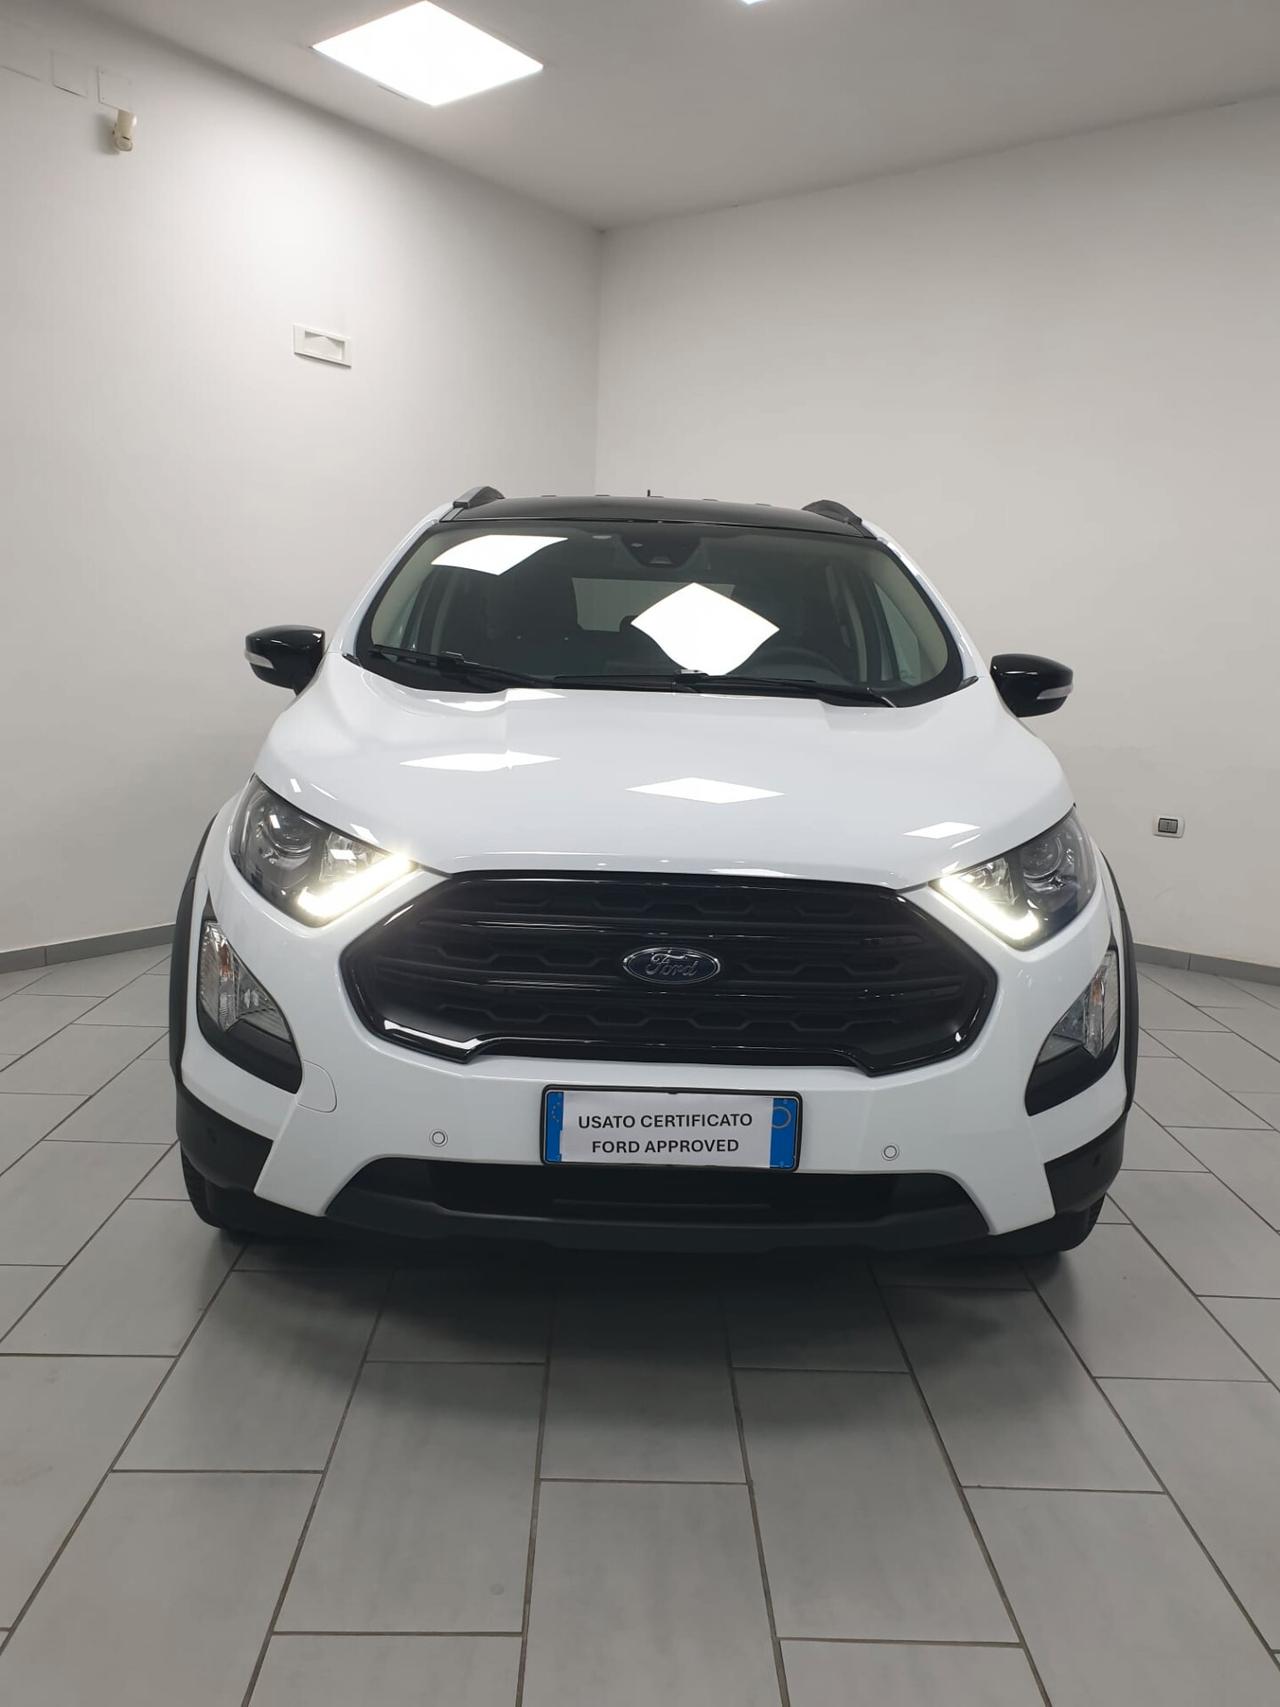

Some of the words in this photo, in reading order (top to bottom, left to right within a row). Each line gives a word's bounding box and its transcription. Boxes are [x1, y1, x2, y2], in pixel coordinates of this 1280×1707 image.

[645, 953, 699, 976] Ford
[578, 1115, 636, 1129] USATO
[640, 1113, 753, 1128] CERTIFICATO
[591, 1140, 640, 1153] FORD
[644, 1139, 739, 1153] APPROVED
